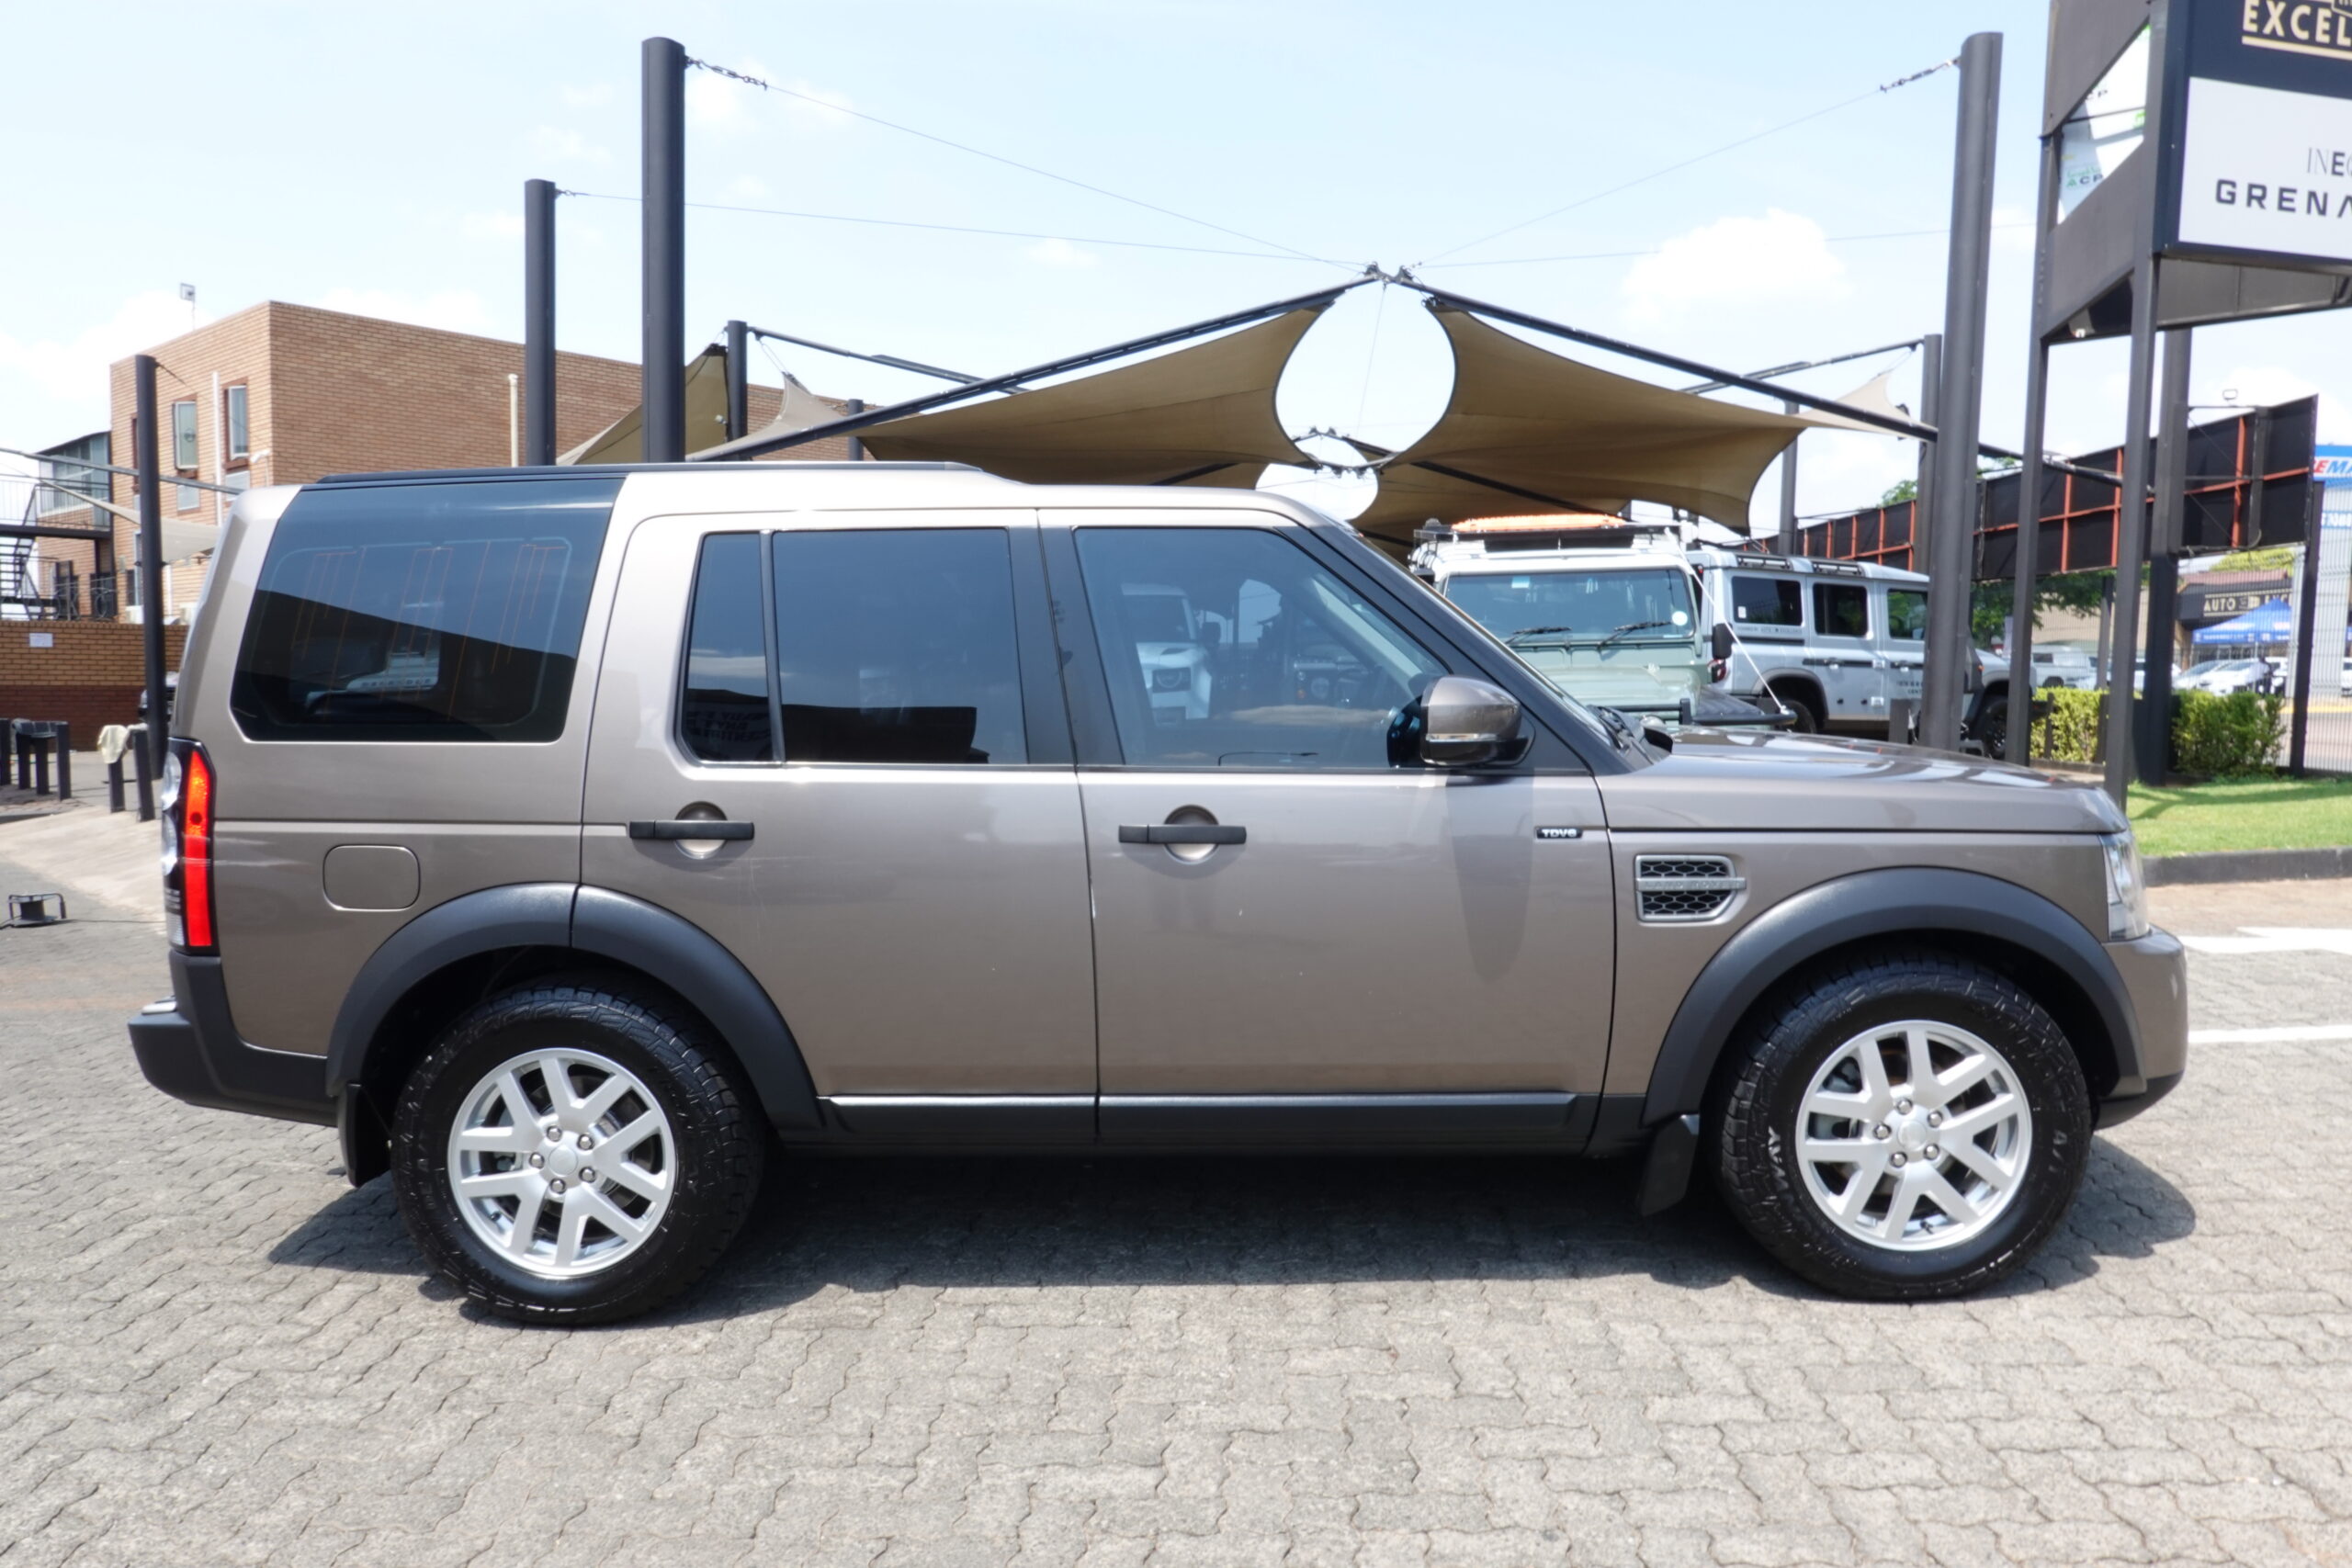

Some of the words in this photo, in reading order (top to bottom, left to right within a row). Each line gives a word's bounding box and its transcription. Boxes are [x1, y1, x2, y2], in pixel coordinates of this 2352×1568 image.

[2243, 0, 2352, 47] EXCEL
[2203, 597, 2236, 613] AUTO
[1542, 829, 1577, 838] TDV6
